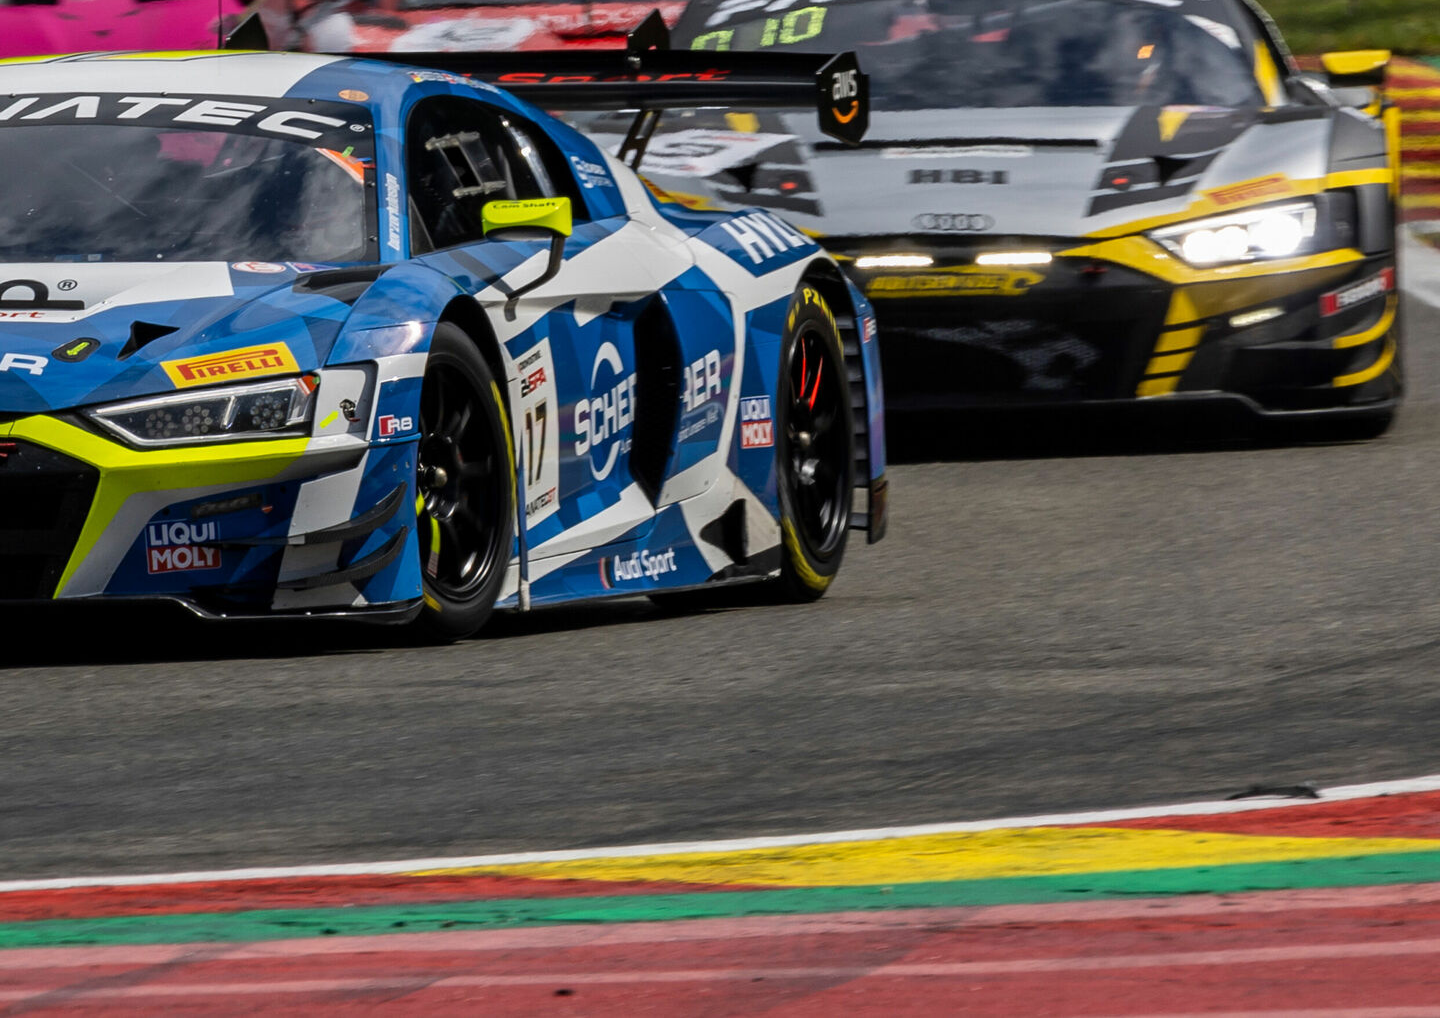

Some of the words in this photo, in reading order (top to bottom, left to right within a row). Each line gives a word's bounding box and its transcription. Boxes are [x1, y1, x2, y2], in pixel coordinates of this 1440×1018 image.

[907, 168, 1009, 185] HBI
[720, 212, 816, 264] HYL
[175, 348, 285, 381] PIRELLI
[740, 397, 771, 421] LIQUI
[388, 416, 414, 433] R8
[741, 421, 774, 446] MOLY
[524, 397, 548, 487] 17
[148, 521, 216, 546] LIQUI
[150, 547, 219, 570] MOLY
[613, 551, 644, 582] Audi
[640, 547, 678, 582] Sport
